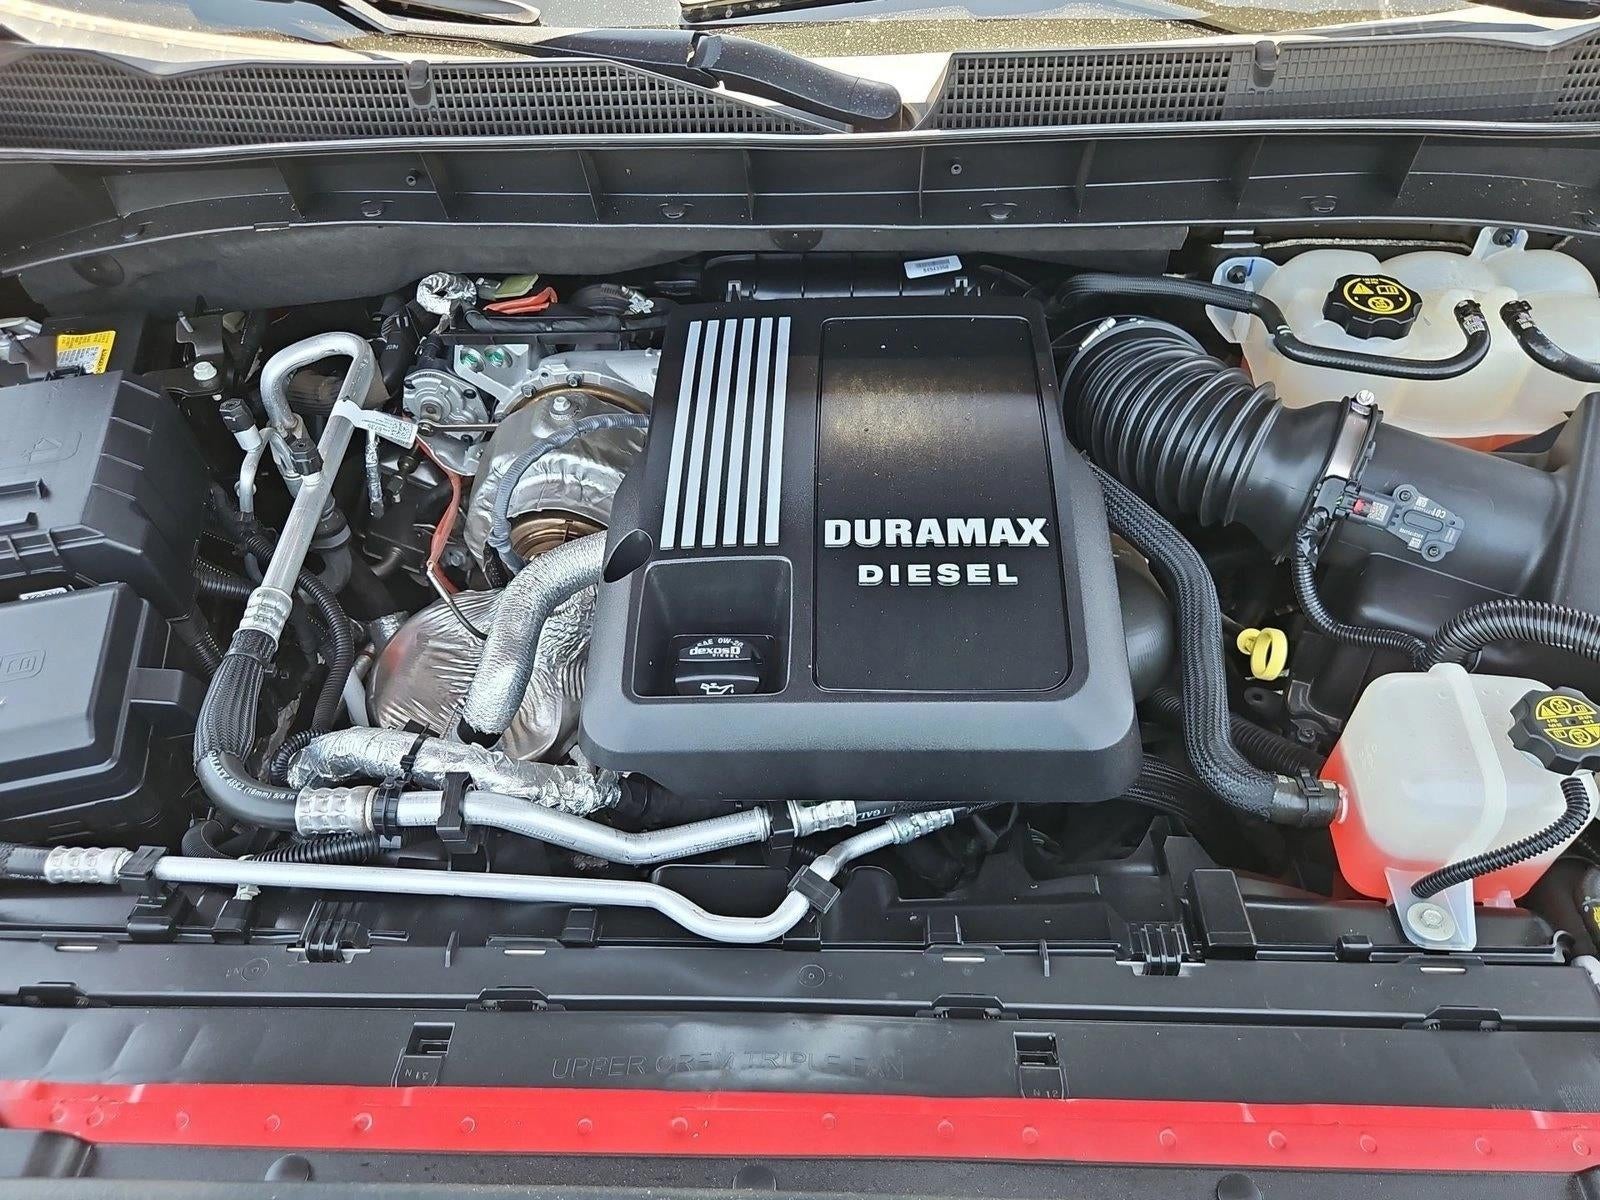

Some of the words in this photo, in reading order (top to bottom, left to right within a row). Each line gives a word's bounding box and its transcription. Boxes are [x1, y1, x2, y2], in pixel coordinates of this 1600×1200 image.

[824, 518, 1050, 548] DURAMAX
[858, 563, 1018, 587] DIESEL
[697, 638, 714, 647] SAE
[207, 750, 230, 779] GALAXY
[552, 1054, 648, 1080] UPPER
